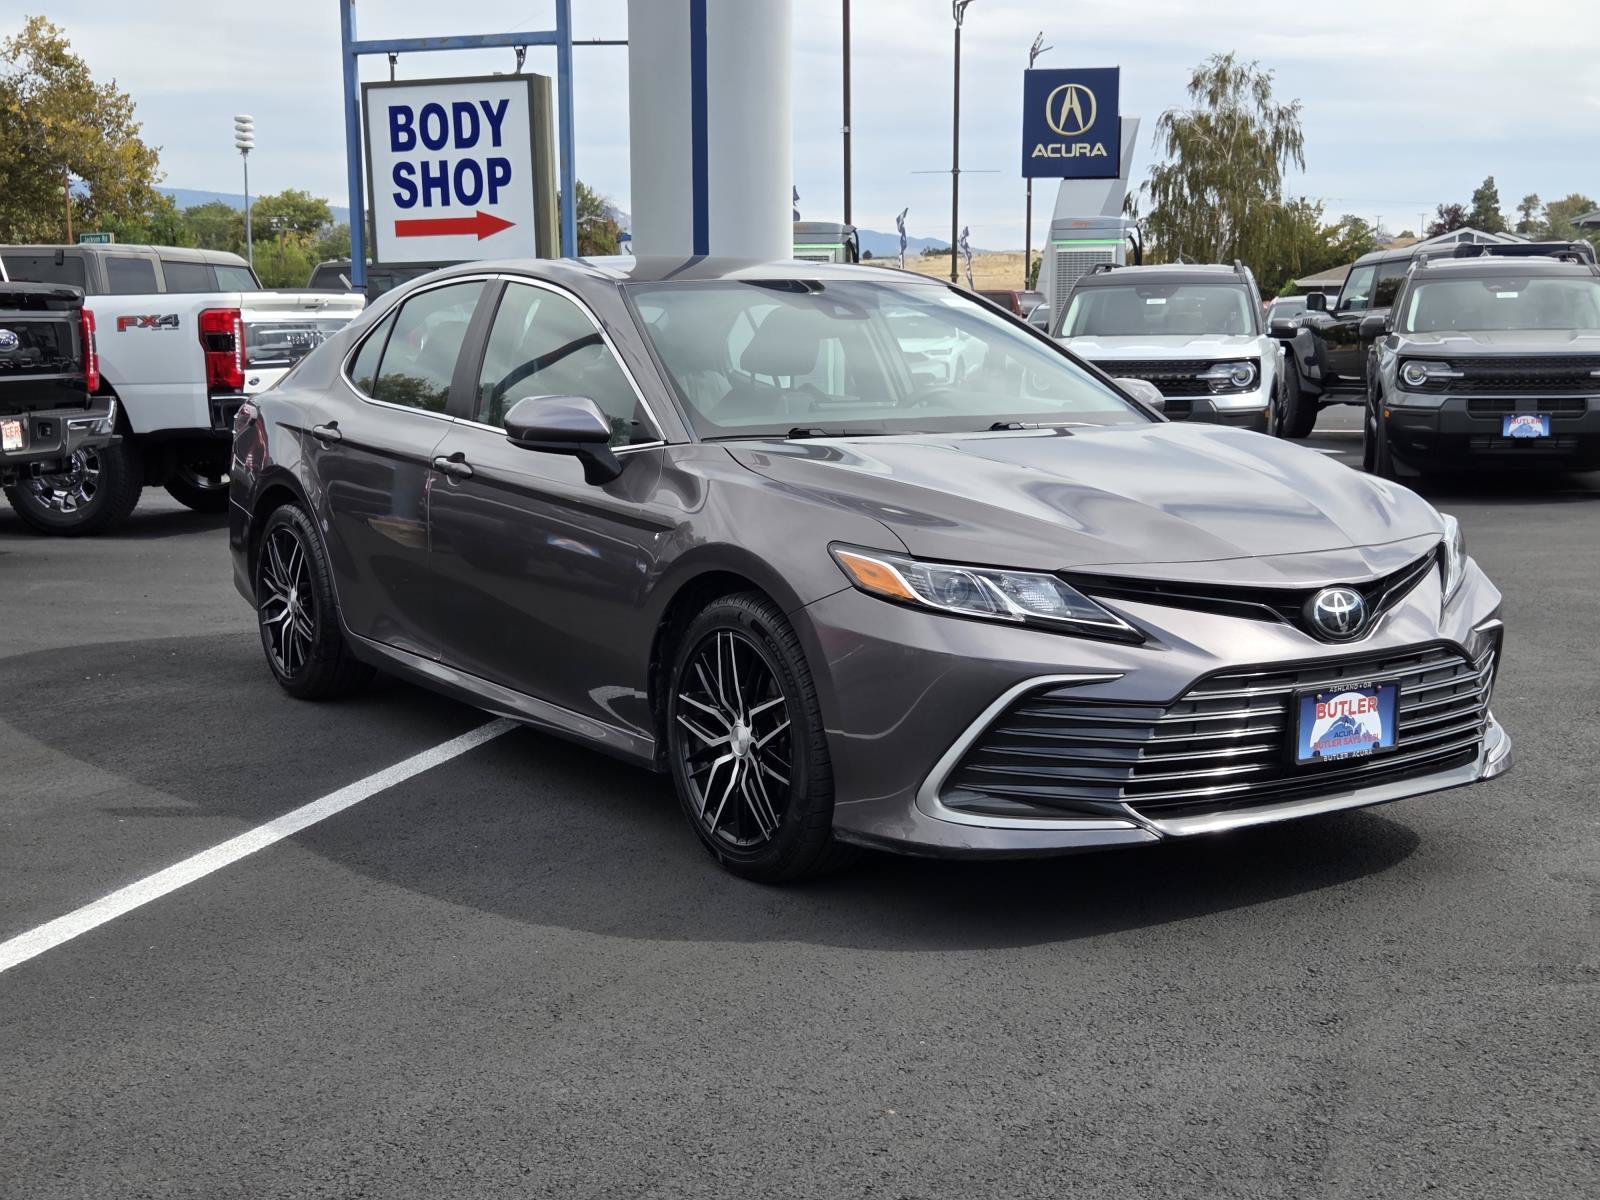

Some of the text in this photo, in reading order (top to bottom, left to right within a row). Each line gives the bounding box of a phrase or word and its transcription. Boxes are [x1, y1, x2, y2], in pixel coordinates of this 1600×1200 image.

[388, 99, 510, 152] BODY
[1031, 142, 1108, 158] ACURA
[392, 157, 512, 209] SHOP
[116, 314, 180, 332] FX4
[1329, 683, 1358, 693] ASHLAND
[1316, 696, 1377, 720] BUTLER
[1334, 729, 1360, 738] ACURA
[1313, 739, 1342, 750] BUTLER
[1323, 750, 1373, 762] BUTLER ACURA
